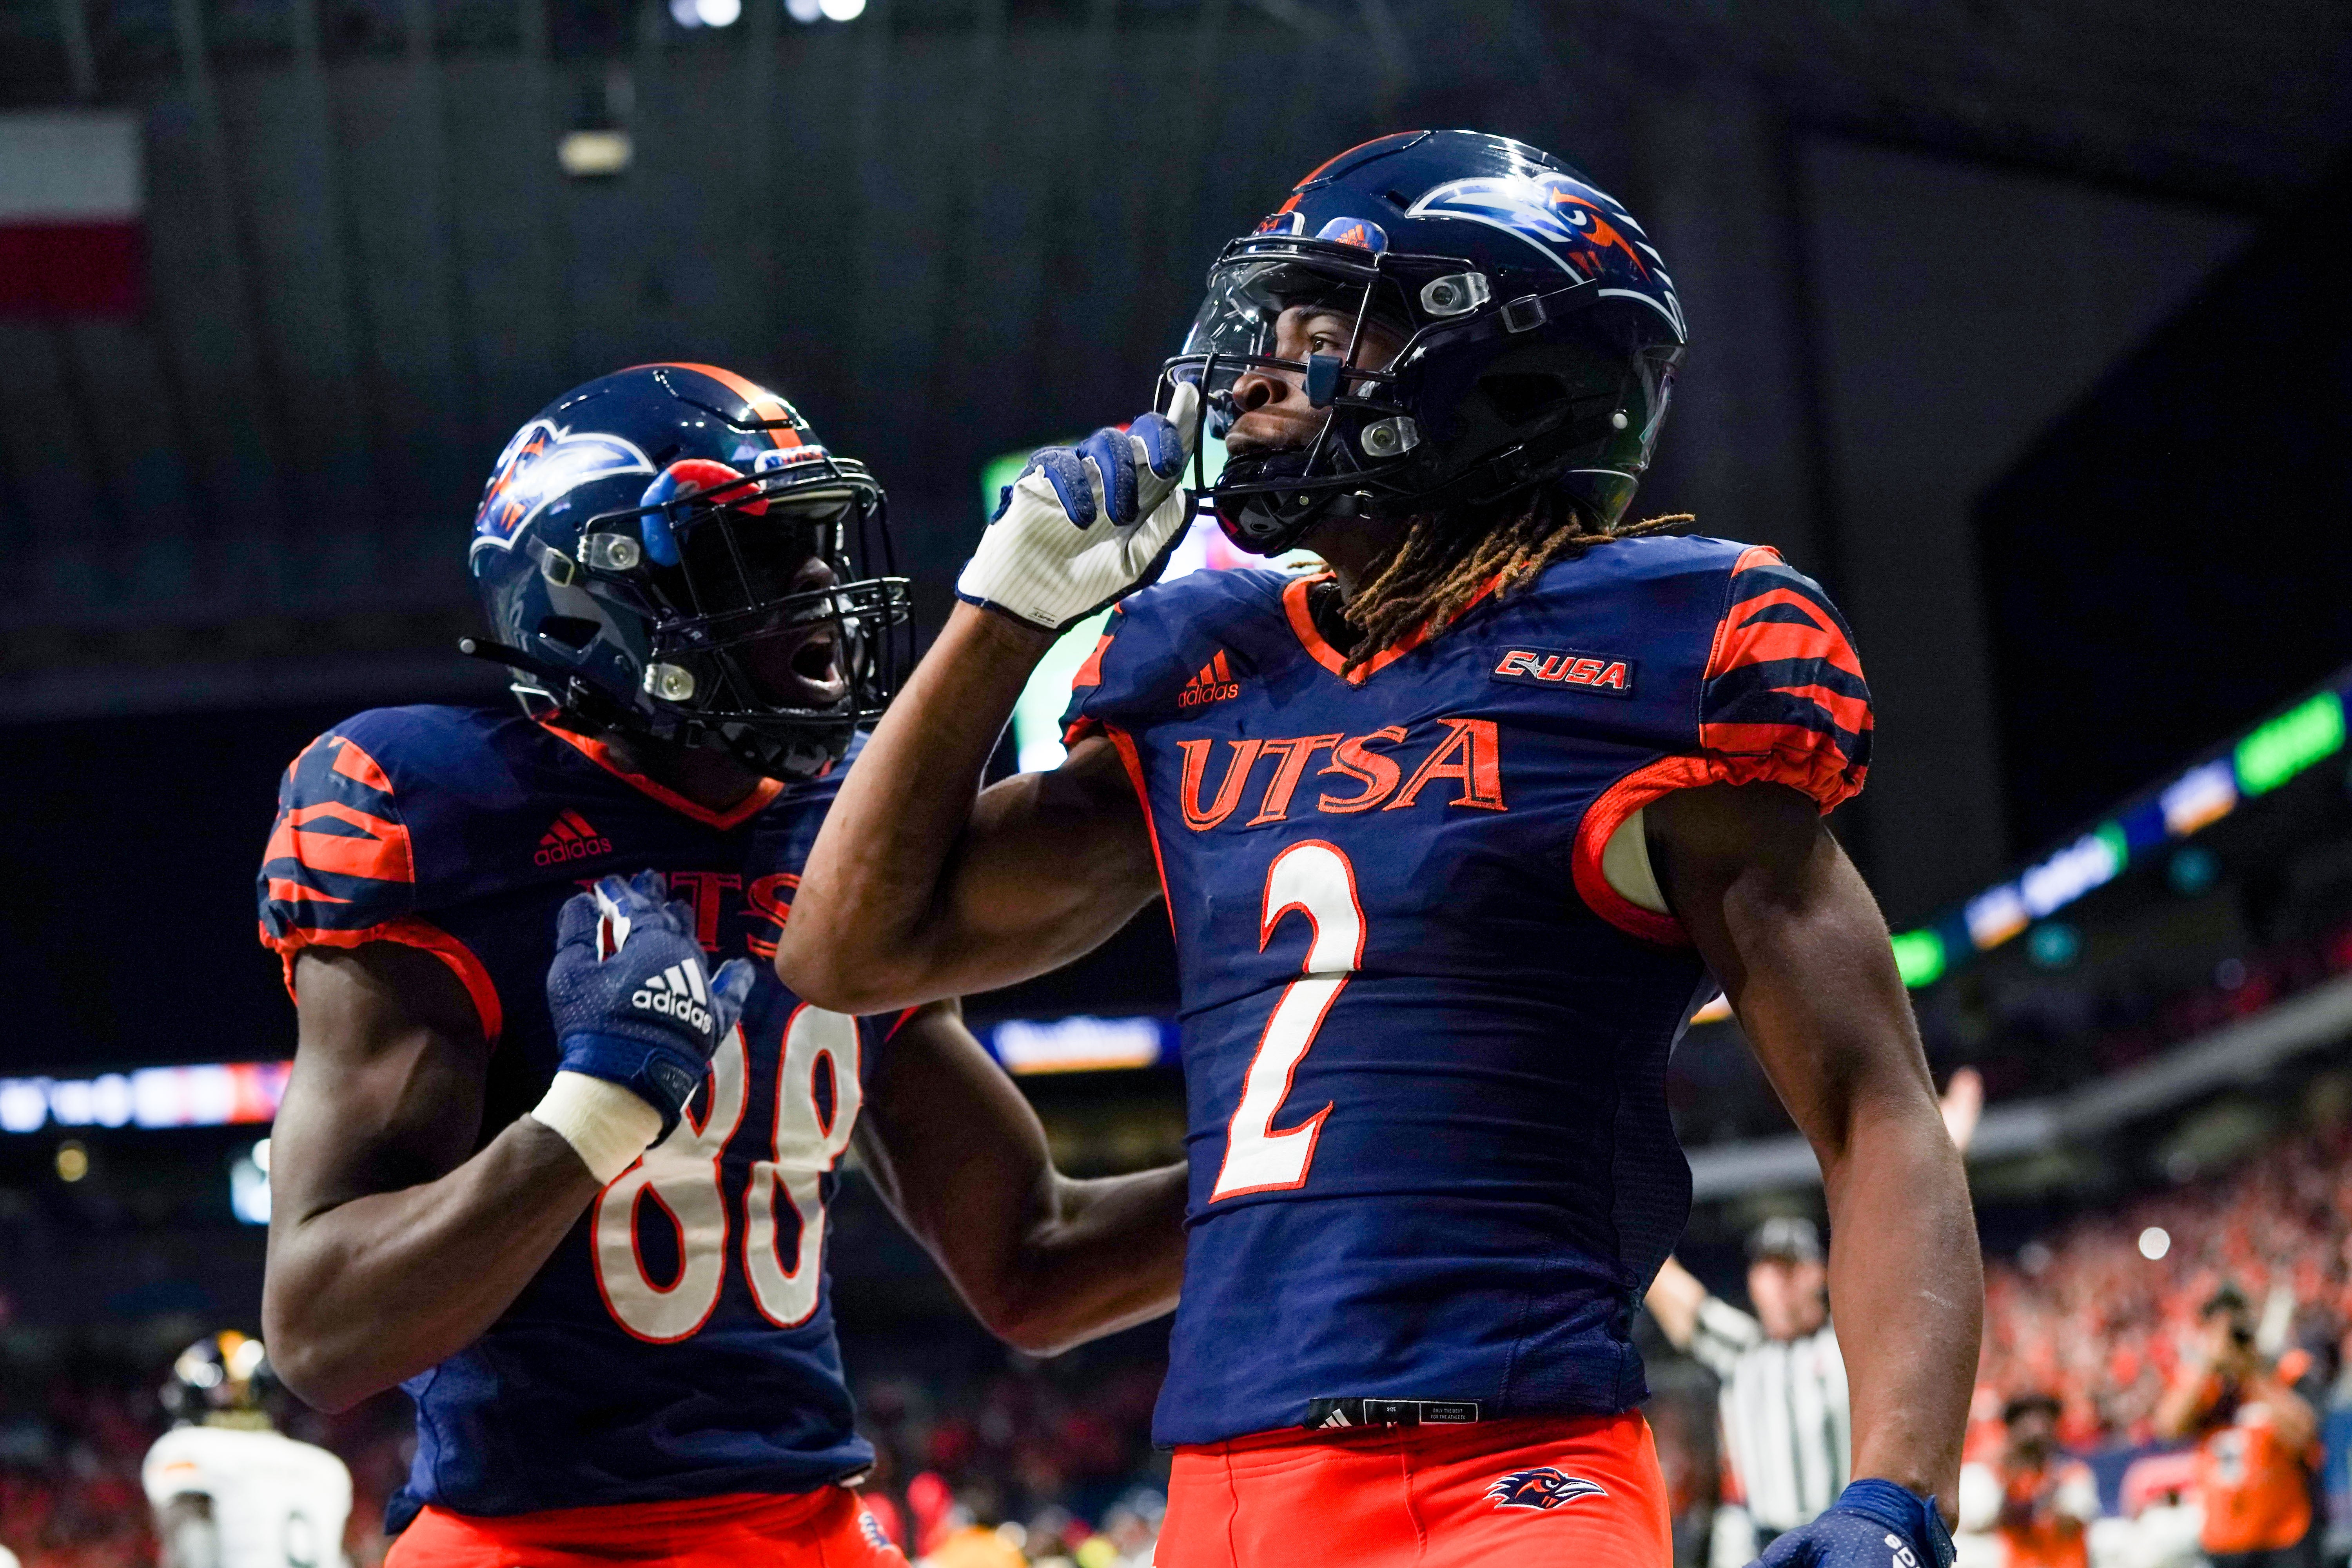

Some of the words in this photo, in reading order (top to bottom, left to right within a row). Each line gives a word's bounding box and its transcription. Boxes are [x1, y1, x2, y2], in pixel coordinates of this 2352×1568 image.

[1178, 682, 1239, 708] adidas
[1176, 719, 1508, 831] UTSA
[534, 837, 612, 866] adidas
[632, 989, 713, 1035] adidas
[1208, 839, 1366, 1203] 2
[591, 1003, 862, 1345] 88
